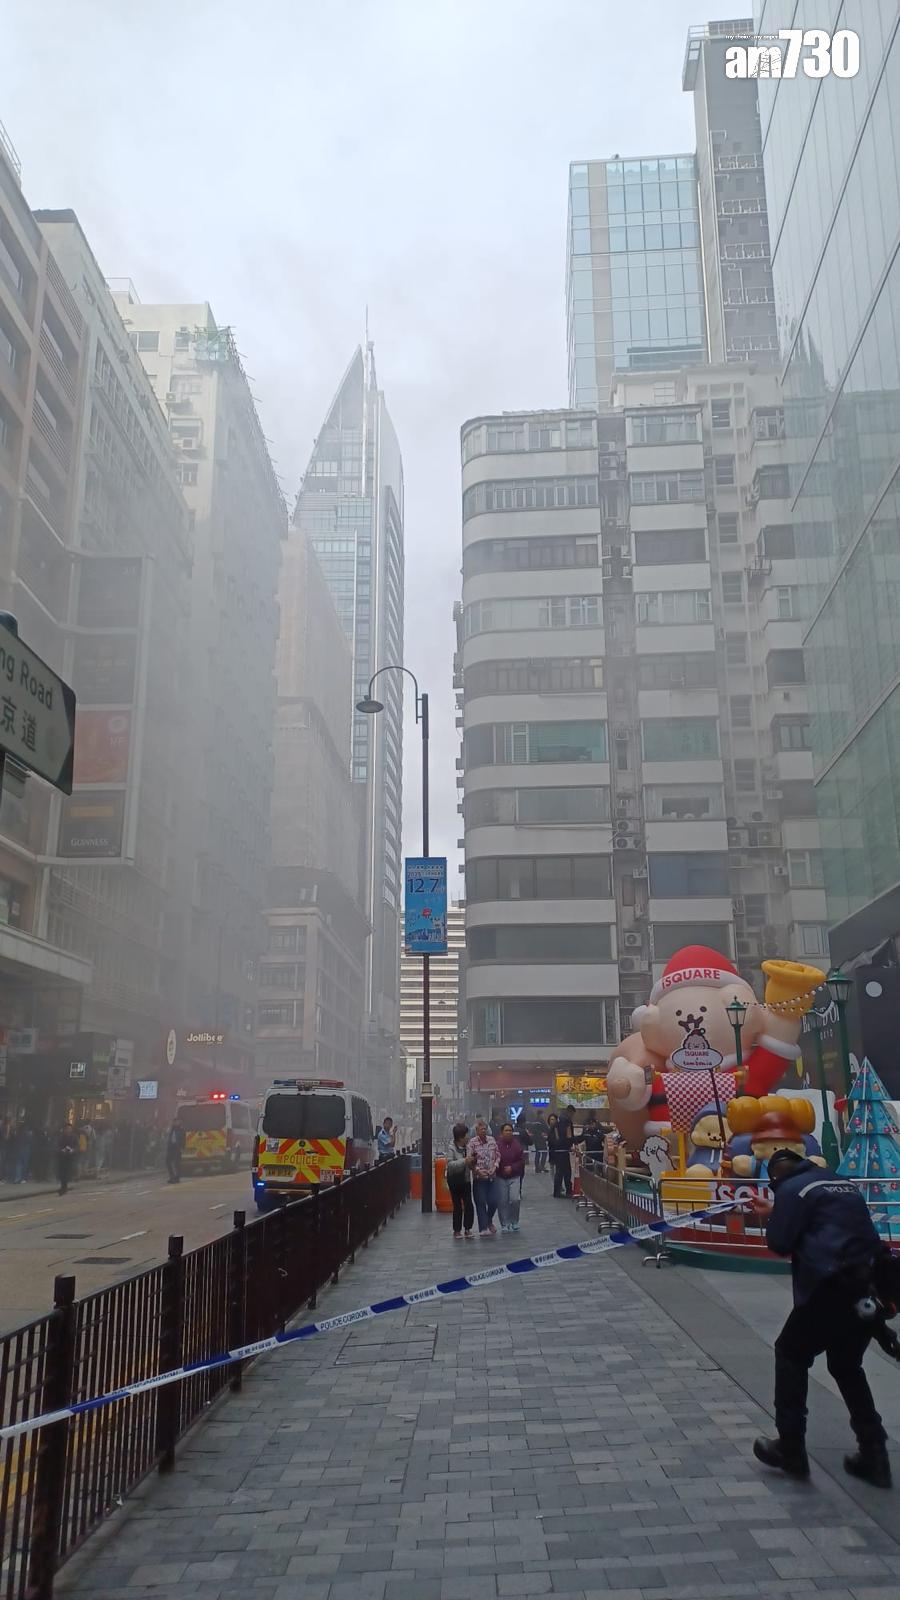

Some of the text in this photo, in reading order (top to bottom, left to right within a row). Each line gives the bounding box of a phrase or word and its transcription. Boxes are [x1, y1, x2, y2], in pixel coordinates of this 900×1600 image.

[20, 659, 53, 711] Road
[1, 695, 37, 752] 京道
[662, 969, 721, 990] iSQUARE
[283, 1154, 318, 1166] POLICE
[320, 1308, 368, 1330] POLICE CORDON
